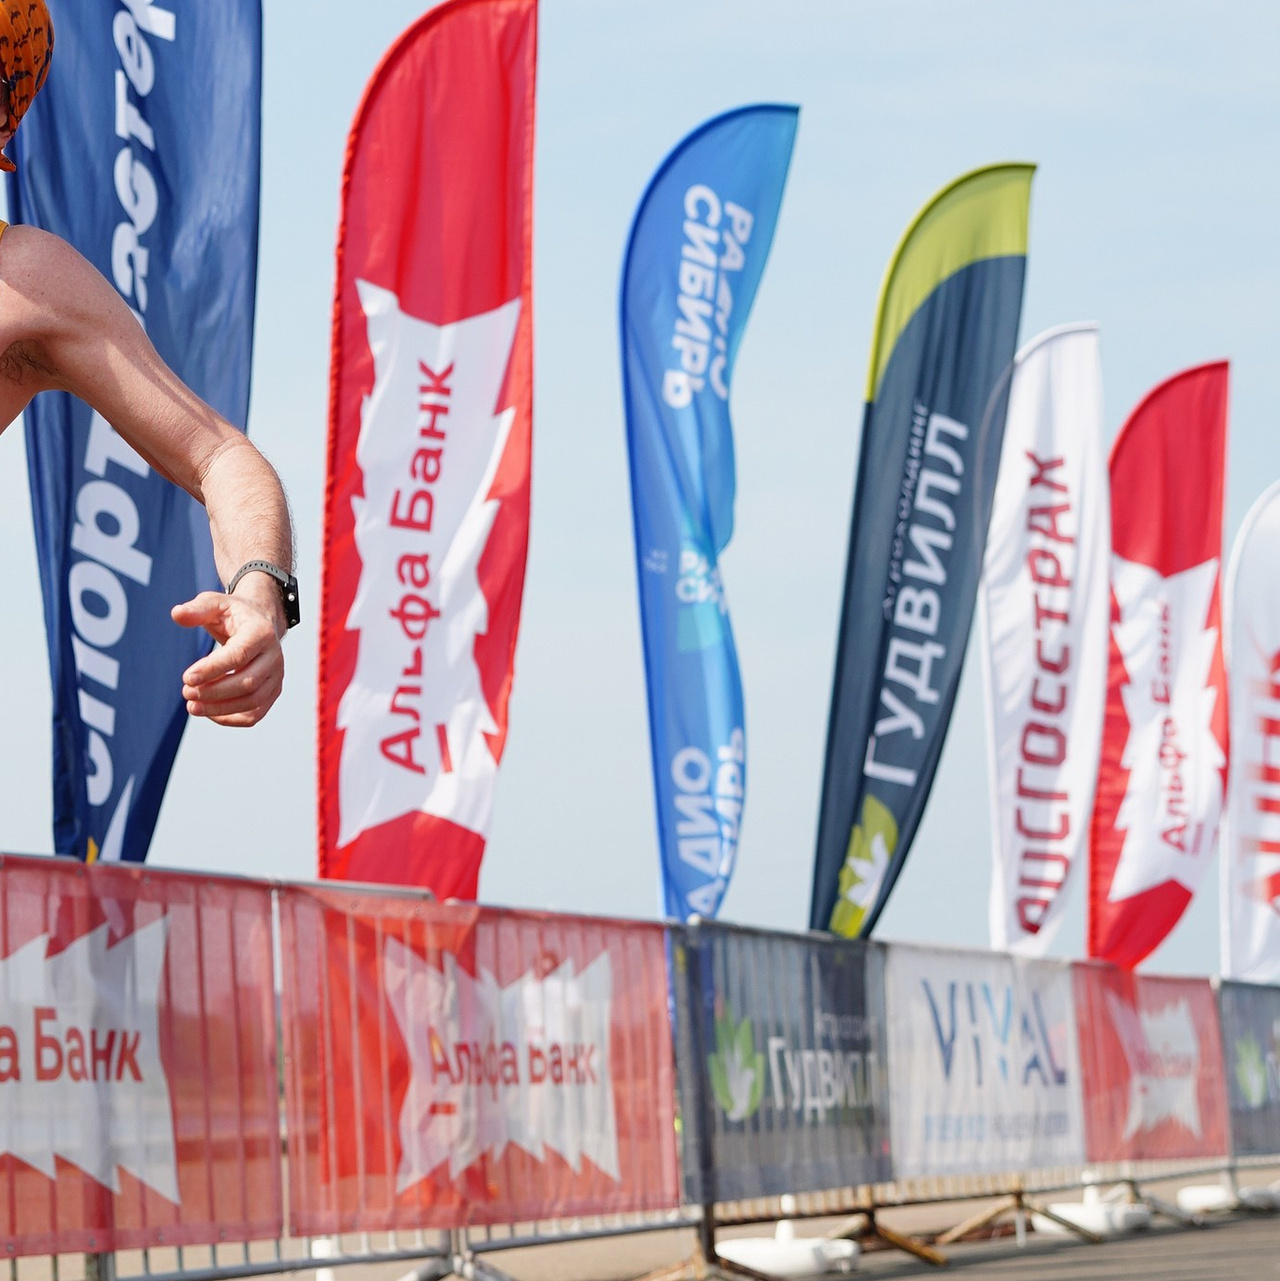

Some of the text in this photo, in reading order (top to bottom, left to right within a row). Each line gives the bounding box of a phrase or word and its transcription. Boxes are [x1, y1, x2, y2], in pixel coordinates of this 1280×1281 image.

[660, 183, 721, 410] СИБИРЬ
[379, 358, 456, 777] Альфа Банк
[32, 1005, 146, 1085] Банк
[426, 1024, 519, 1102] Альфа
